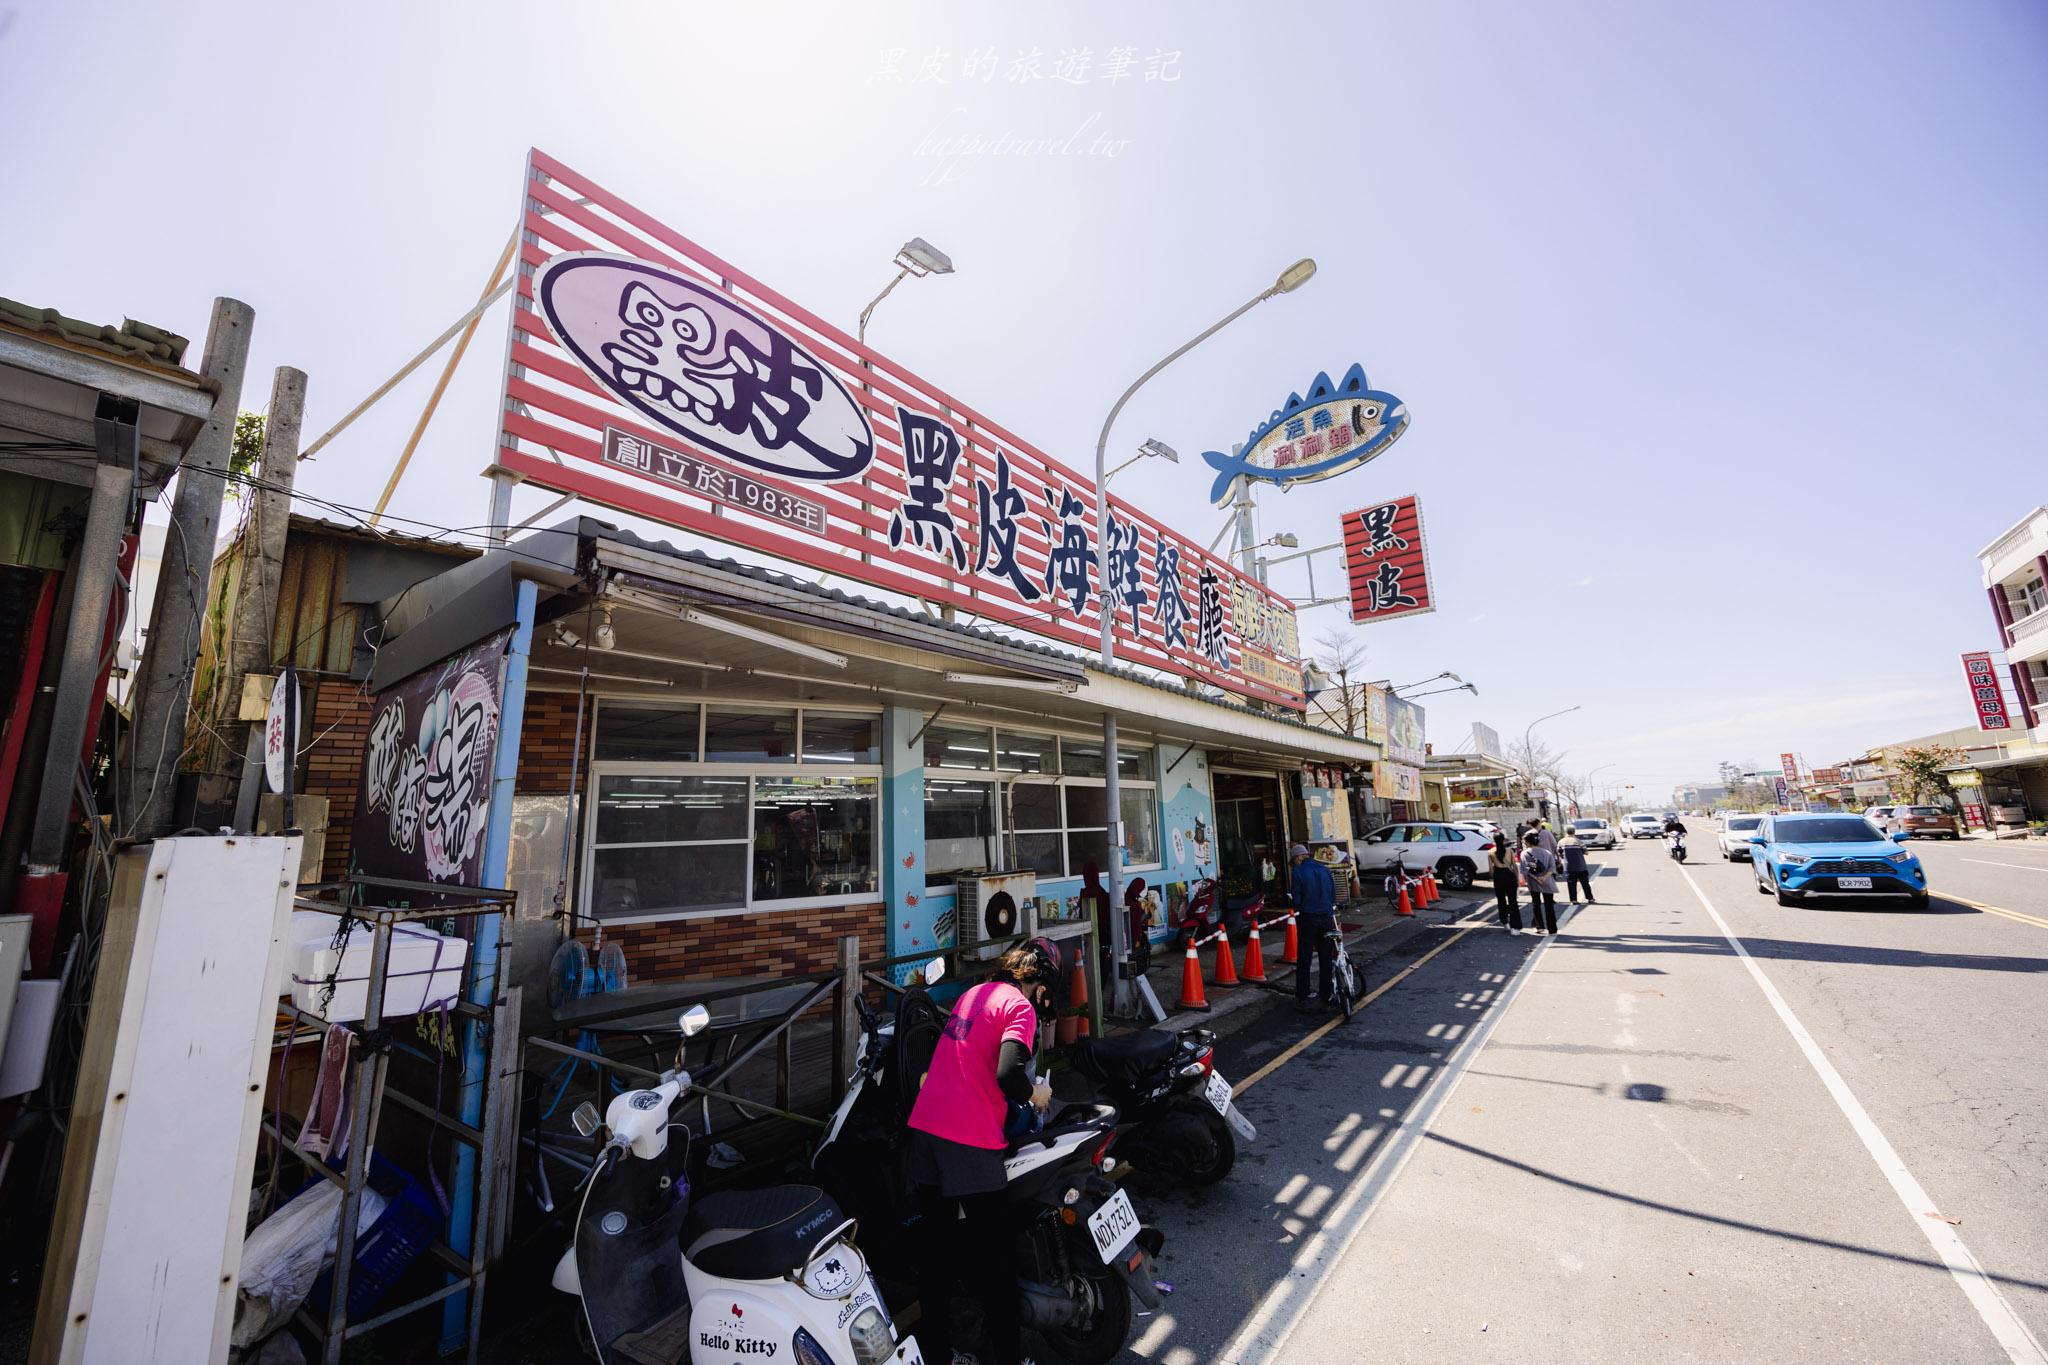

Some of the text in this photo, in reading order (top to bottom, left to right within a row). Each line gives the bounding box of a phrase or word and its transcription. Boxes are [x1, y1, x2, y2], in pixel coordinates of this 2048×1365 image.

[1273, 424, 1353, 468] 涮涮鍋
[1285, 411, 1334, 440] 活魚
[615, 437, 820, 528] 創立於1983年
[887, 402, 1231, 672] 黑皮海鮮餐廳
[1360, 503, 1418, 612] 黑皮
[1969, 660, 2004, 728] 霸味薑母鴨
[795, 1209, 833, 1239] KYMCO
[1094, 1201, 1136, 1252] NDX-7321
[700, 1333, 777, 1357] Hello Kitty
